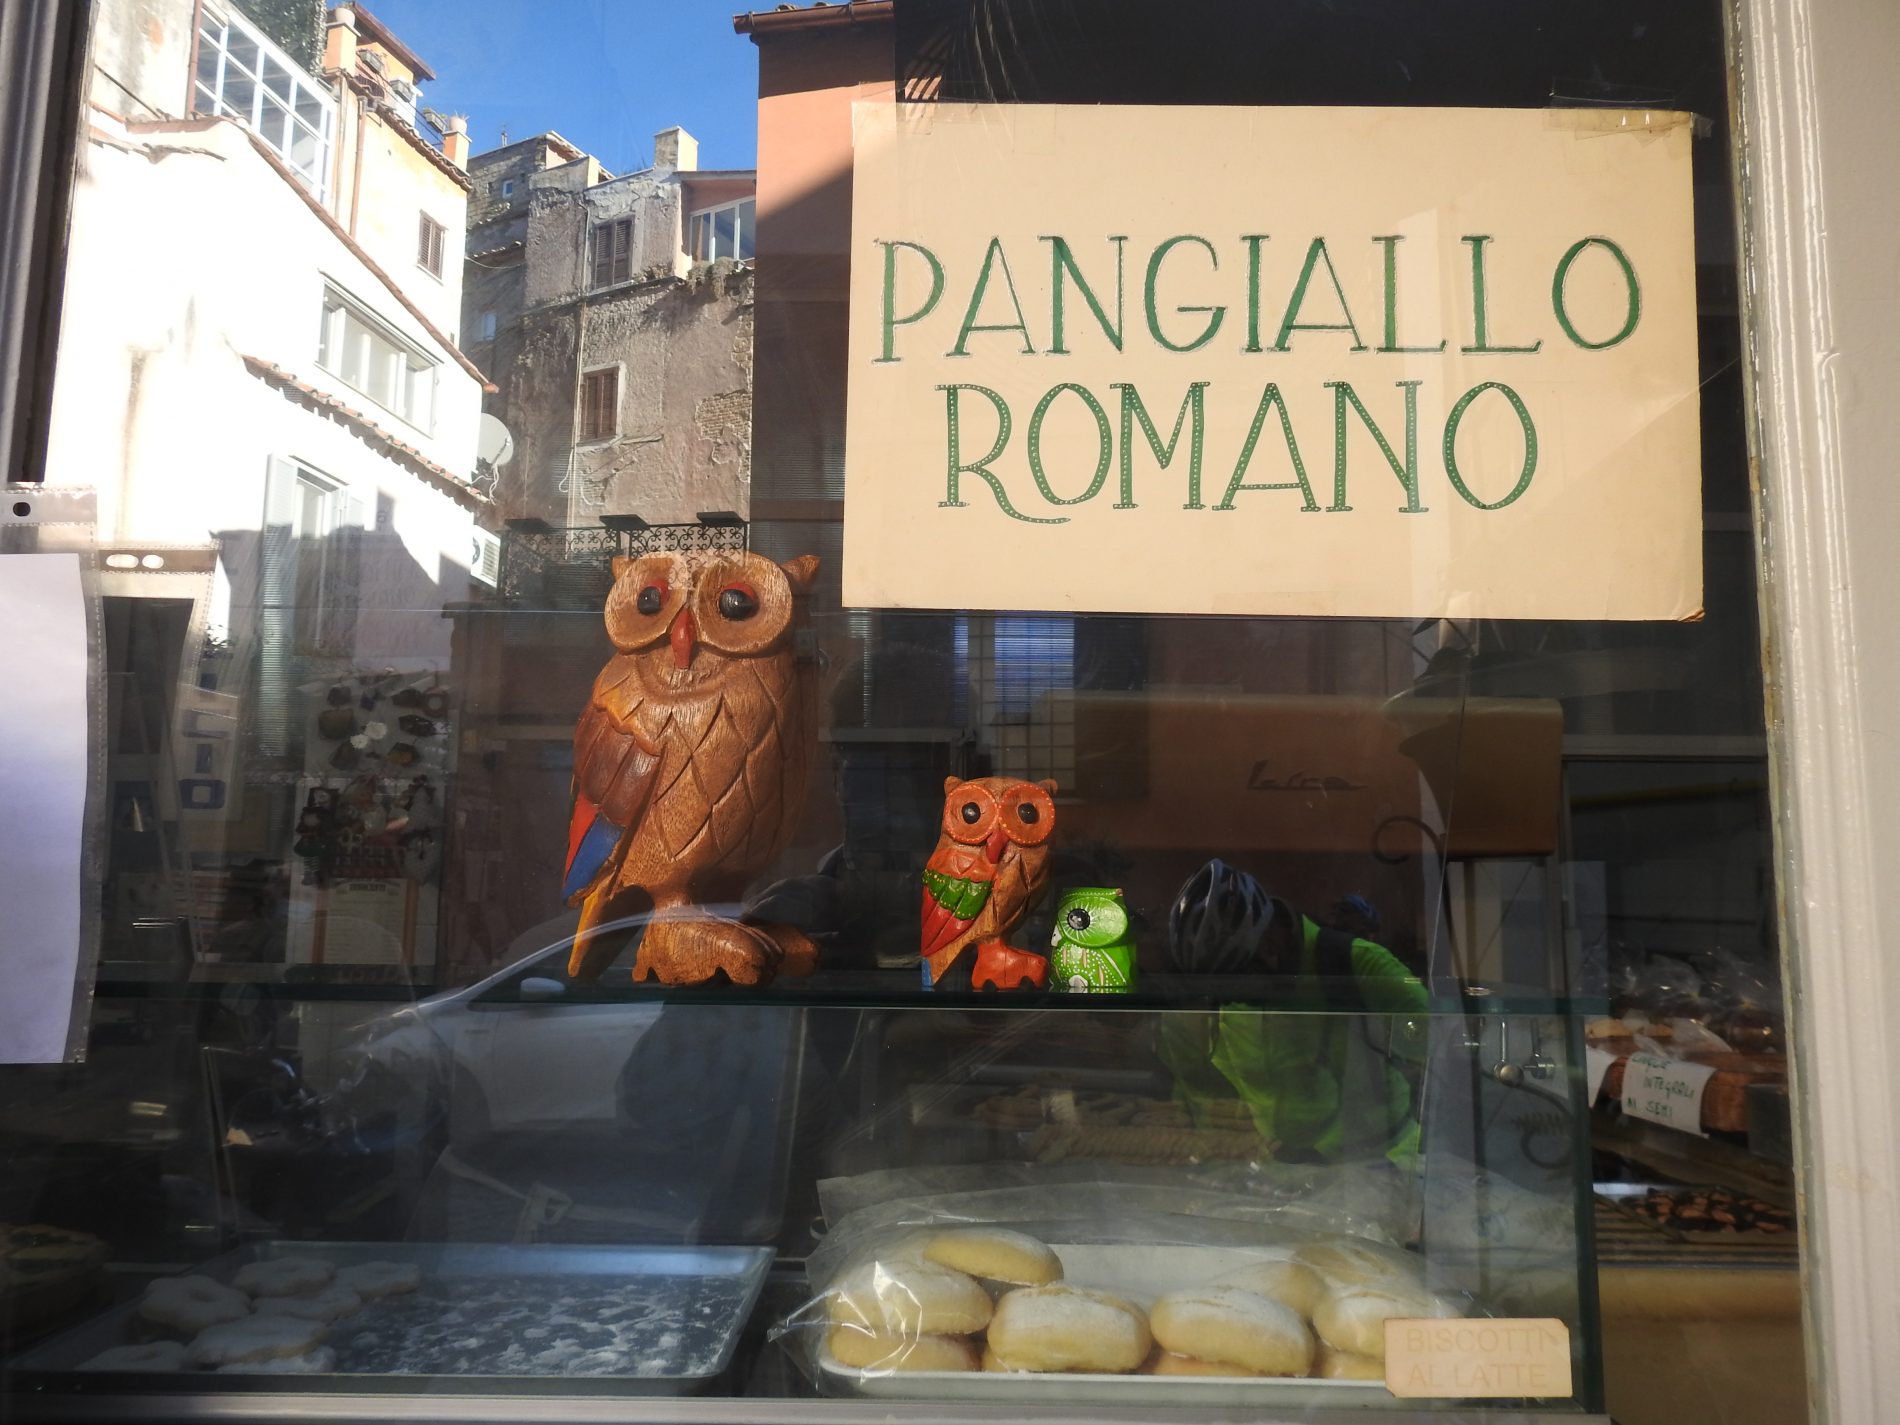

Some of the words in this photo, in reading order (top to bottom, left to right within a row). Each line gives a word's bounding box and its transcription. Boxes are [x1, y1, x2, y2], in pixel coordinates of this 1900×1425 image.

[872, 234, 1642, 363] PANGIALLO
[935, 381, 1538, 523] ROMANO
[1407, 1364, 1442, 1388] AL
[1454, 1364, 1547, 1388] LATTE
